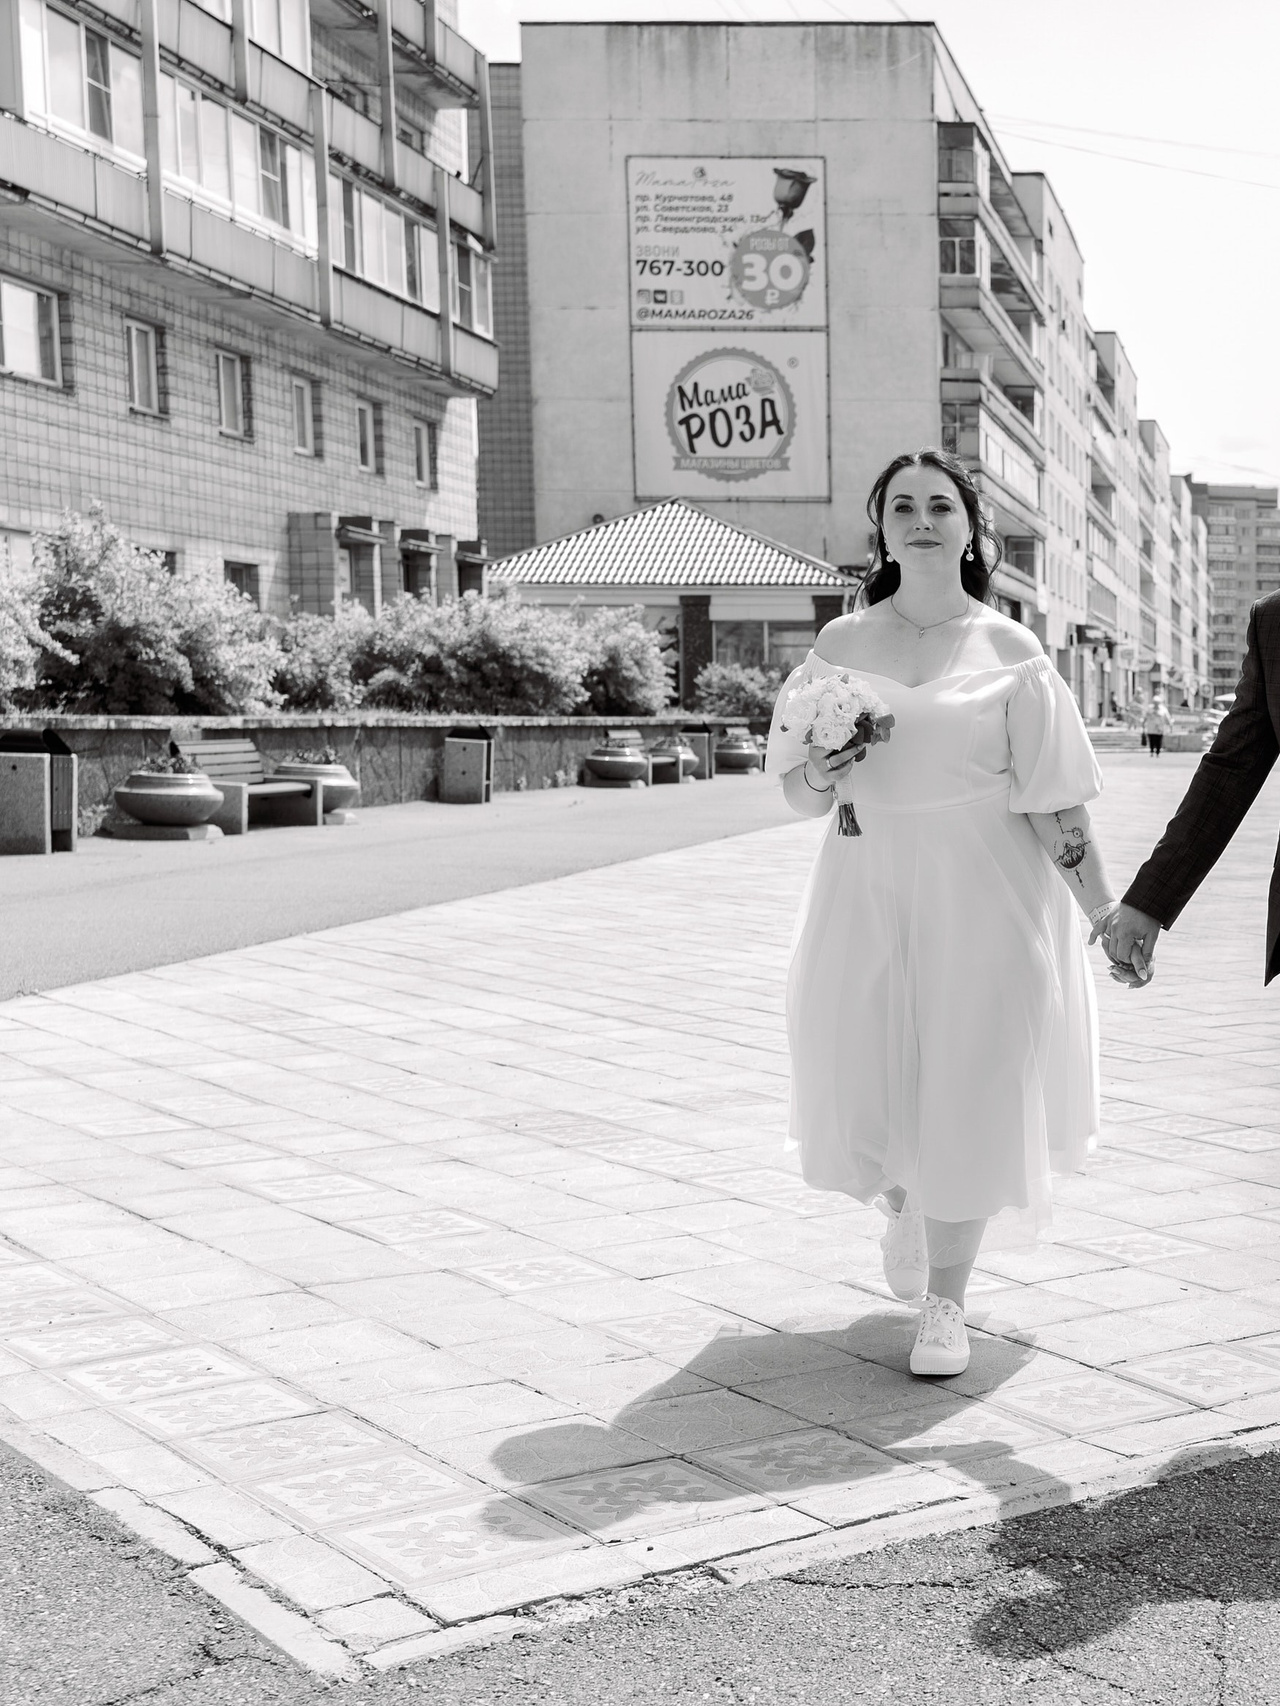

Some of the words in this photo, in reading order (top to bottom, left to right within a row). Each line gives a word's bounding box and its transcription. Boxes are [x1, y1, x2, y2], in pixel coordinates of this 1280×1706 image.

[634, 194, 651, 203] пр.
[654, 194, 716, 204] Курчатова,
[634, 204, 649, 213] ул.
[653, 204, 714, 214] Советская,
[635, 214, 651, 223] пр.
[655, 213, 747, 224] Ленинградский,
[635, 225, 649, 234] ул.
[653, 224, 718, 234] Свердлова,
[635, 245, 680, 257] ЗВОНИ
[635, 259, 725, 277] 767-300
[741, 252, 804, 292] 30
[636, 308, 755, 321] @MAMAROZA26
[677, 380, 751, 412] Мама
[677, 397, 785, 455] РОЗА
[679, 457, 739, 470] МАГАЗИНЫ
[740, 457, 782, 470] ЦВЕТОВ
